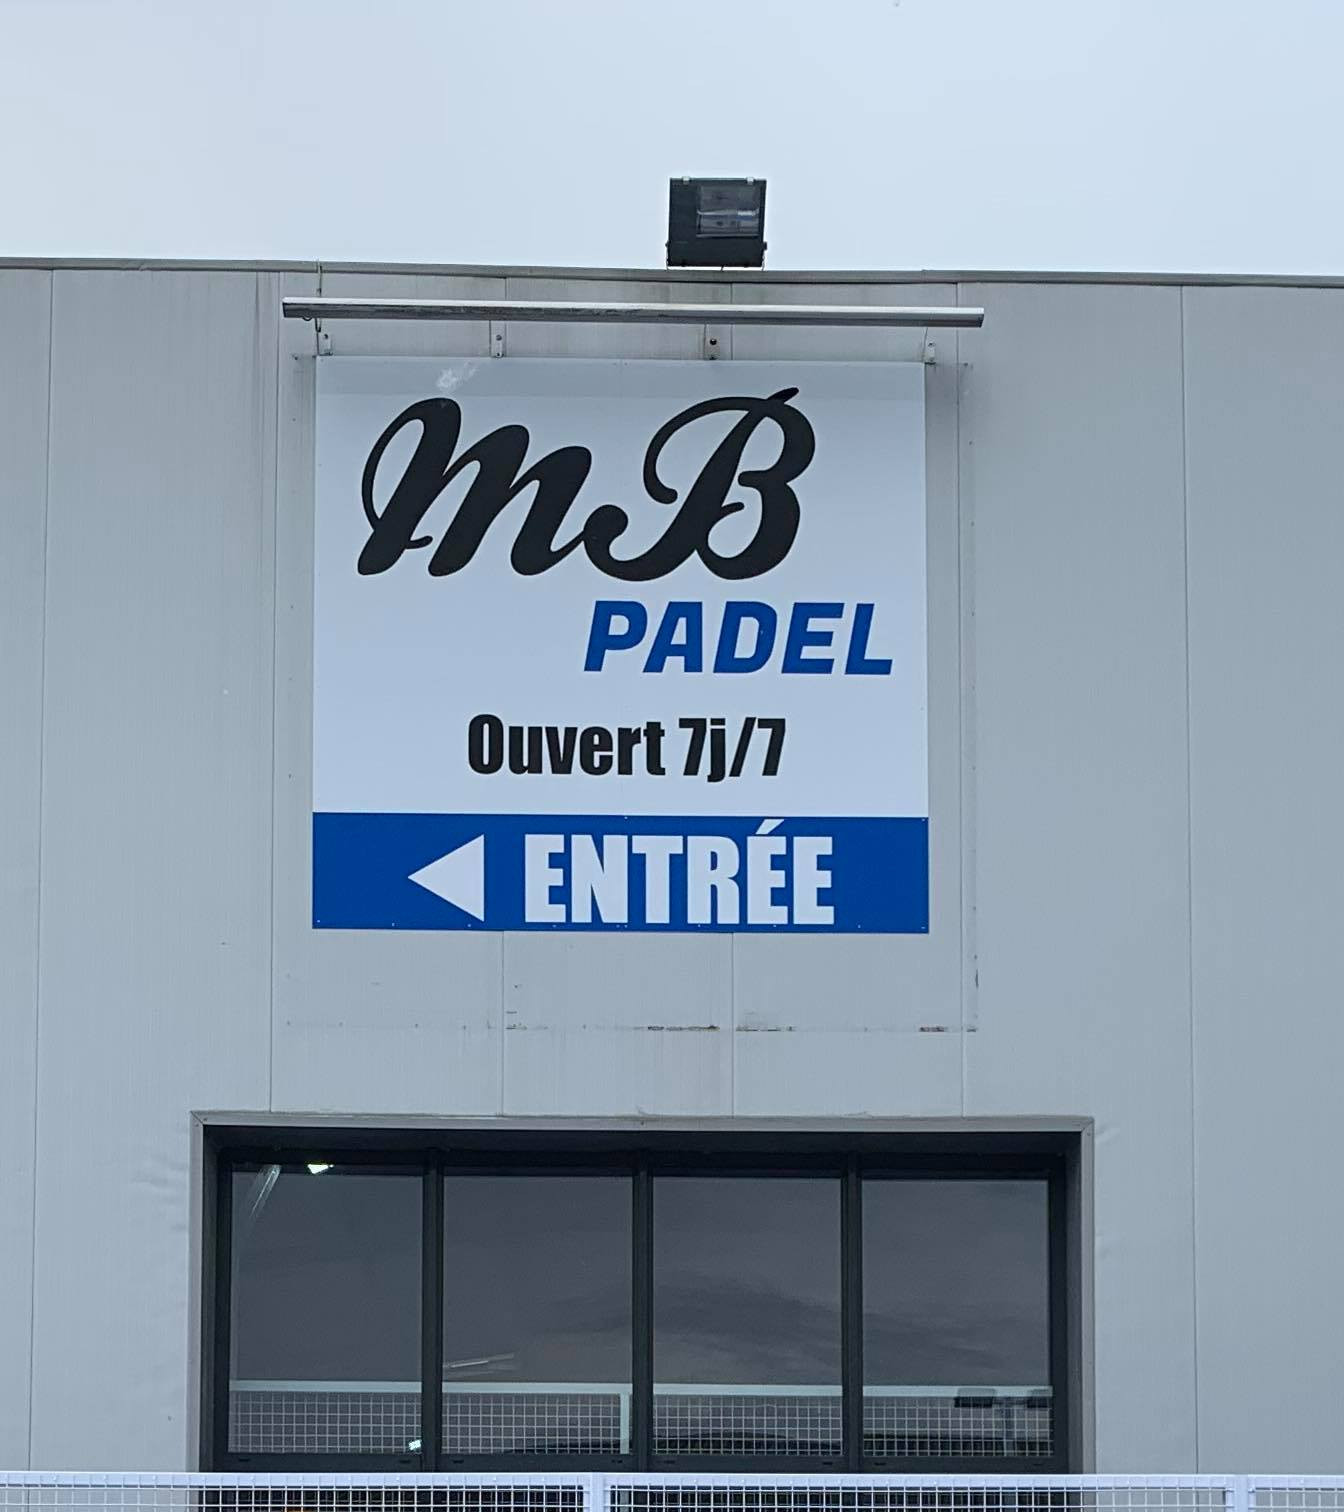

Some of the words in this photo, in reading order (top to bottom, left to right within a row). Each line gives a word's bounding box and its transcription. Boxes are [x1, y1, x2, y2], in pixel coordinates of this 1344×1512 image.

[357, 386, 816, 582] MB
[583, 600, 893, 675] PADEL
[468, 713, 666, 776] Ouvert
[678, 717, 786, 783] 7j/7
[524, 818, 835, 925] ENTRÉE
